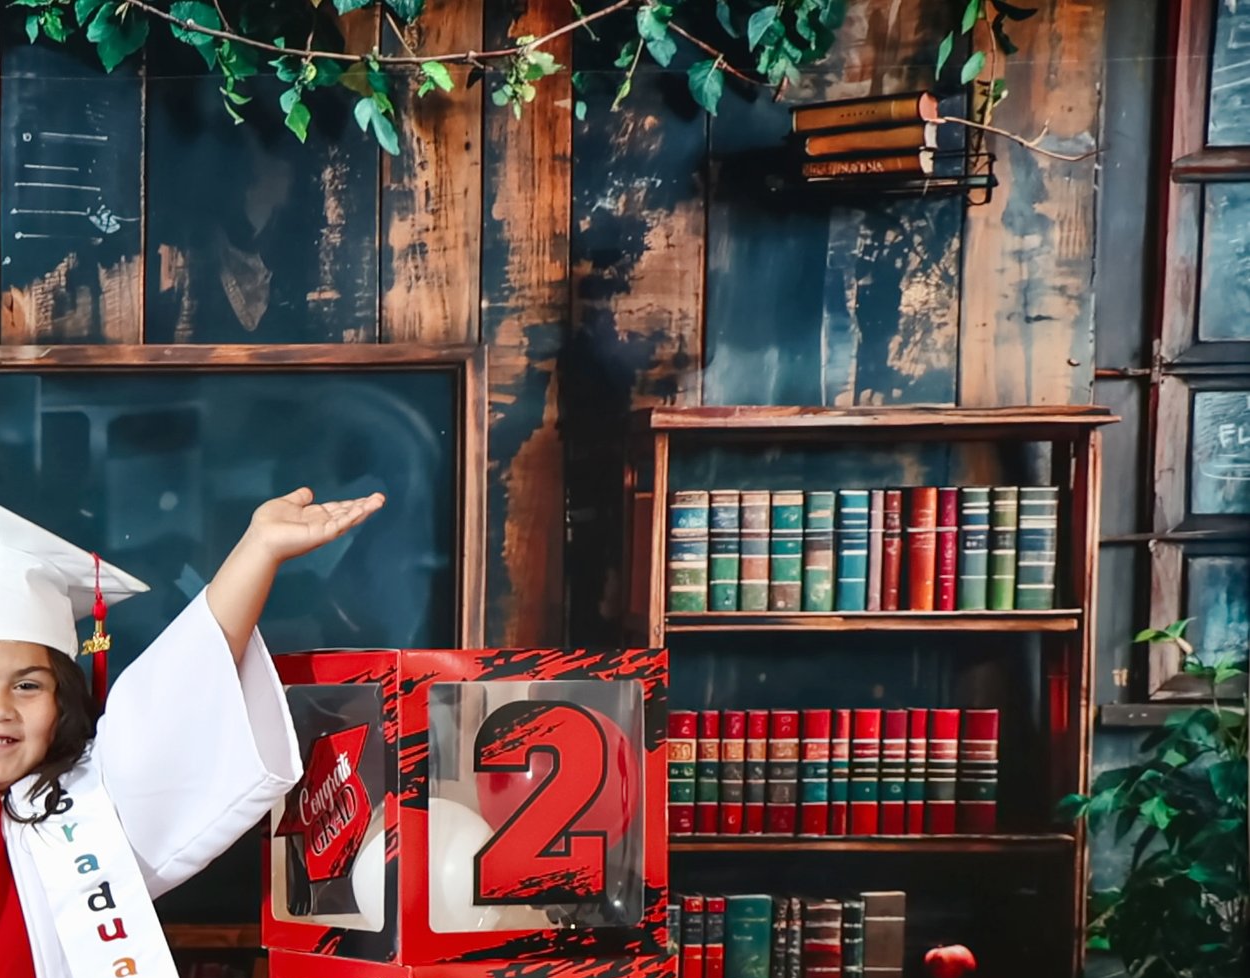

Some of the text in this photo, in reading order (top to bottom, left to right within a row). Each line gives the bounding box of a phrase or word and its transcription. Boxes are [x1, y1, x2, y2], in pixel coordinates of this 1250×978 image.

[299, 751, 352, 826] Congrats
[310, 784, 358, 857] GRAD
[472, 699, 609, 906] 2
